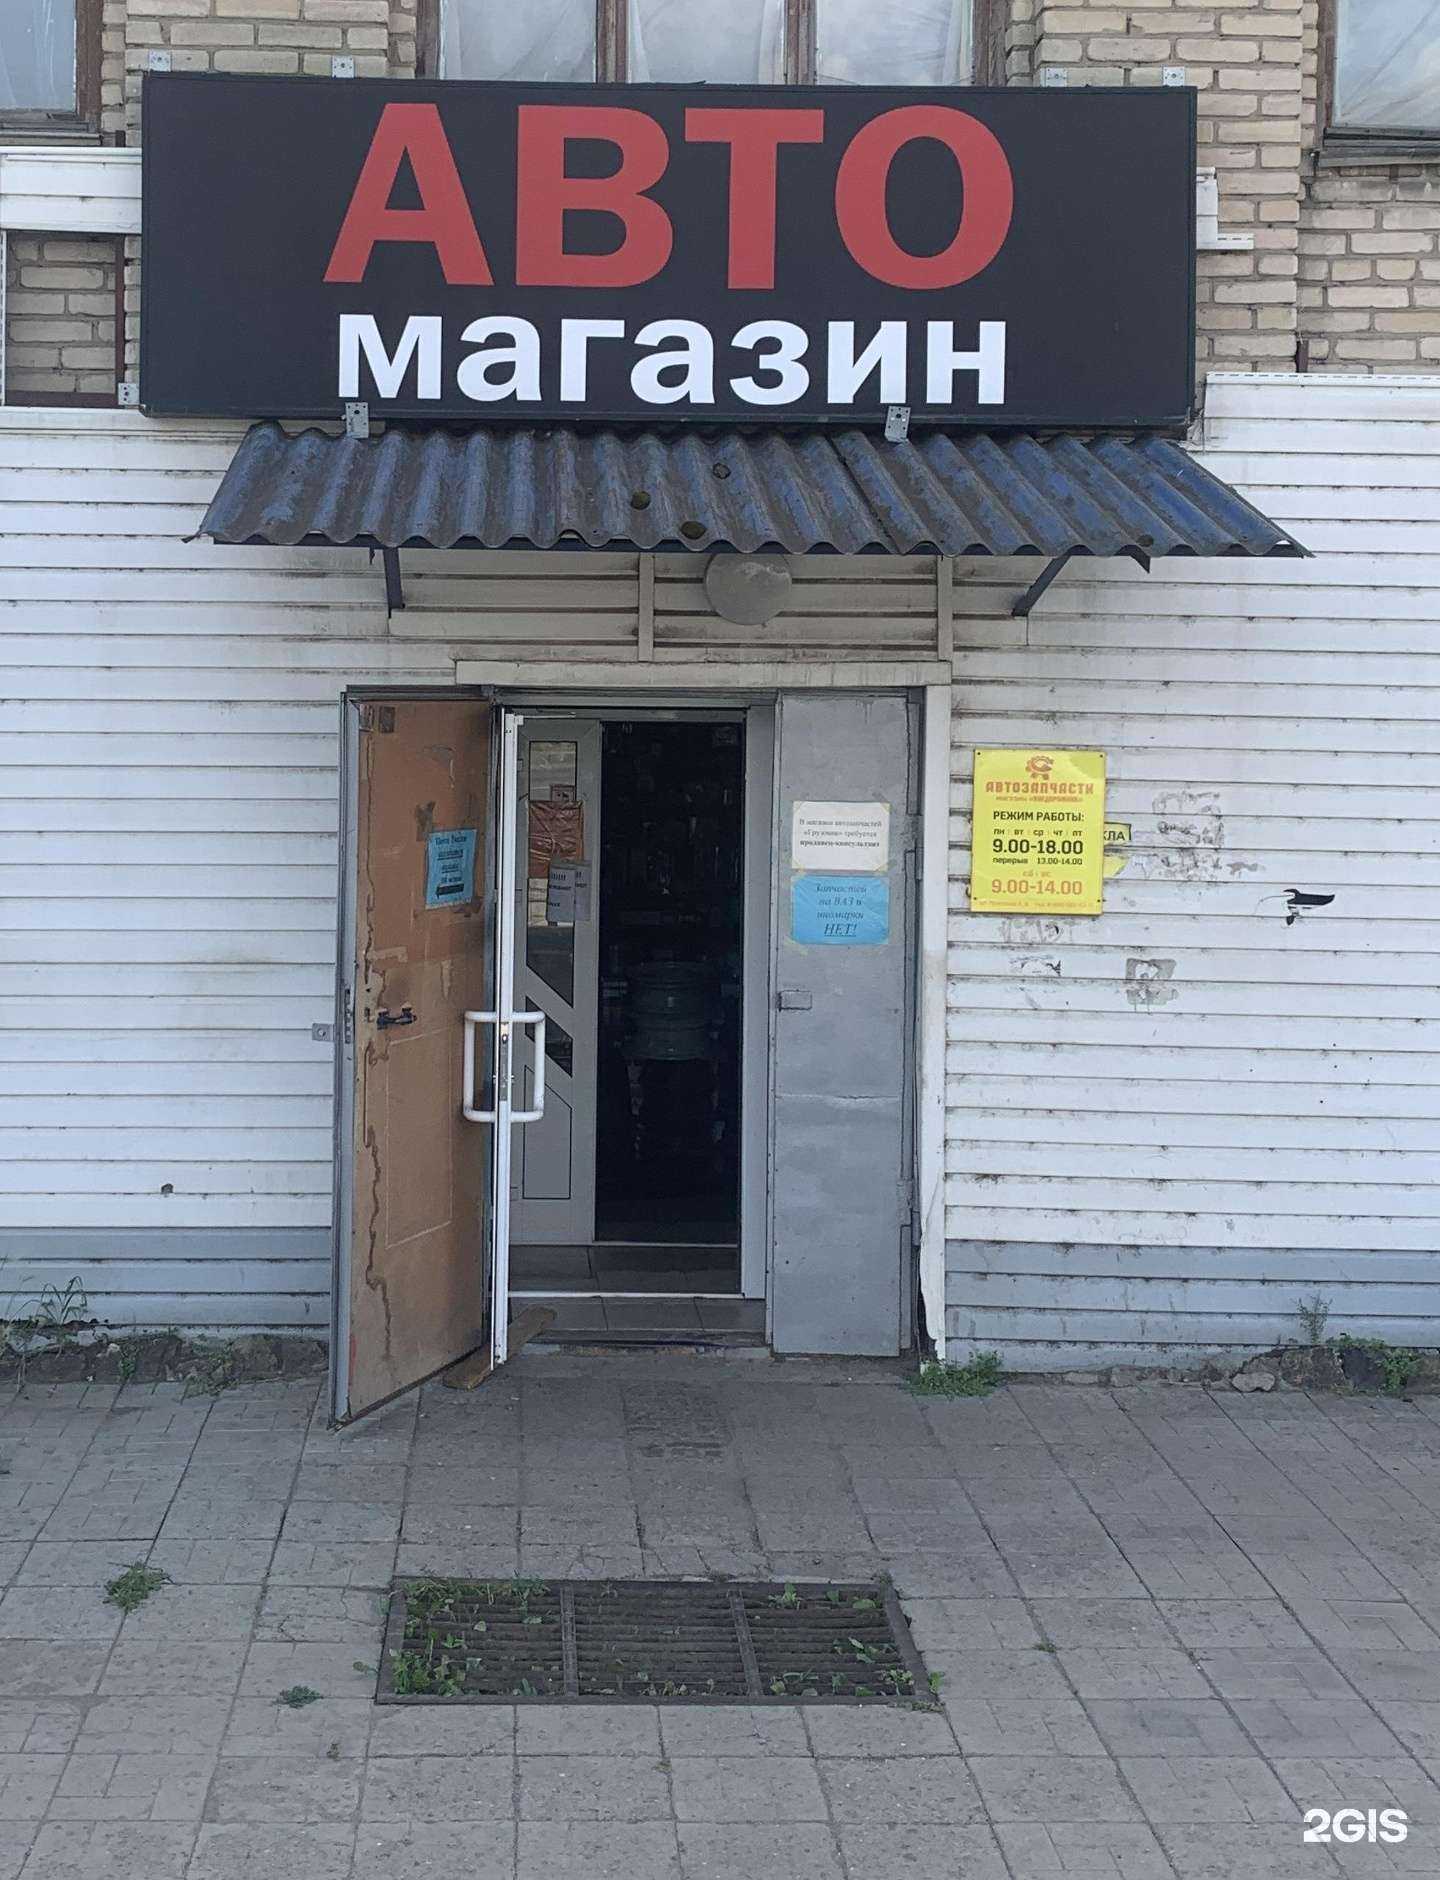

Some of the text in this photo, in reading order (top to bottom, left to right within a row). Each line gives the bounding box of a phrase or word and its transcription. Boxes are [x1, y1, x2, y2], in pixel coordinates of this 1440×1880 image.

[322, 102, 1015, 291] АВТО
[338, 314, 1006, 405] магазин
[985, 781, 1094, 795] АВТОЗАПЧАСТИ
[993, 811, 1085, 822] РЕЖИМ РАБОТЫ:
[992, 838, 1084, 855] 9.00-18.00
[991, 879, 1083, 895] 9.00-14.00
[824, 923, 858, 936] НЕТ!
